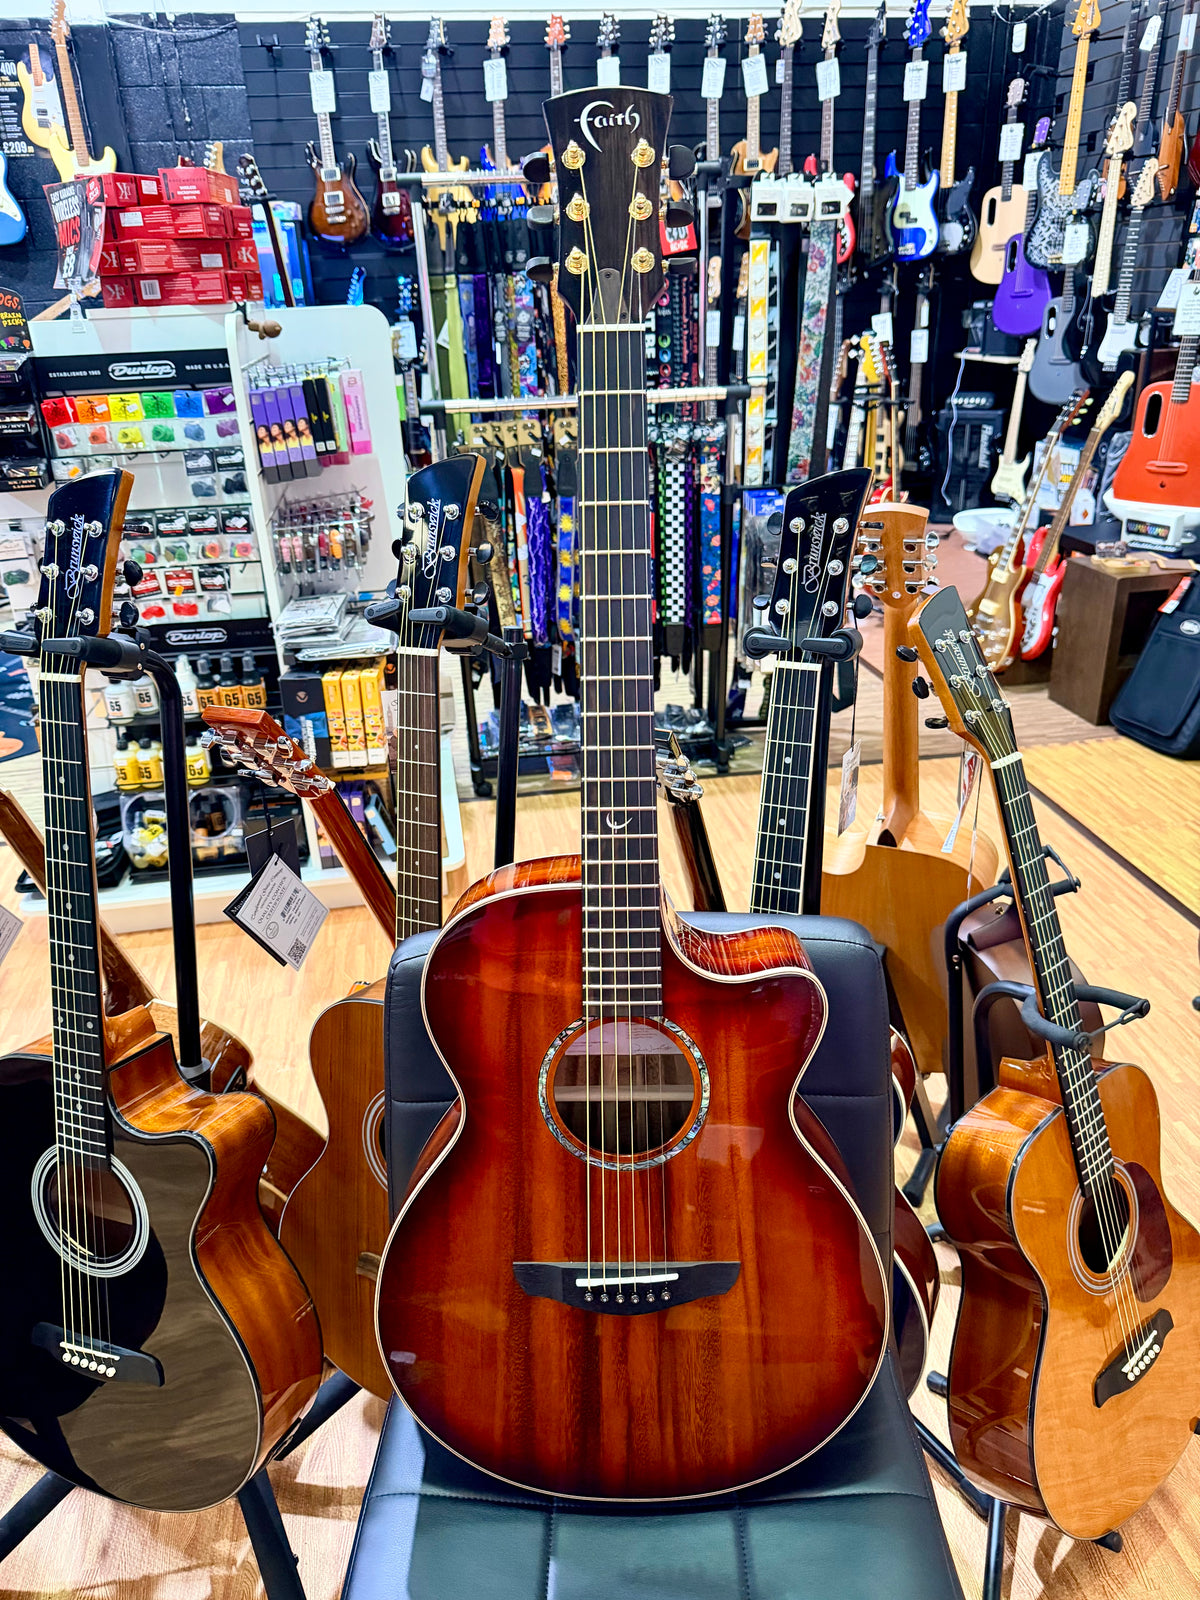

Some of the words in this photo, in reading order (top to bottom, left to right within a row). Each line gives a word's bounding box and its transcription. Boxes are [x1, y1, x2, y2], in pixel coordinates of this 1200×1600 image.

[574, 100, 641, 152] Faith
[3, 141, 28, 154] £209
[58, 215, 81, 249] MICS
[48, 370, 88, 378] ESTABLISHED
[112, 363, 173, 377] Dunlop
[421, 498, 442, 579] Brunswick
[64, 513, 85, 599] Brunswick
[801, 511, 827, 593] Brunswick
[168, 631, 225, 643] Dunlop
[138, 692, 151, 704] 65
[224, 693, 240, 706] 65
[247, 693, 262, 706] 65
[109, 701, 122, 712] 65
[265, 886, 287, 920] CERTIFICATE
[257, 900, 274, 925] QUALITY
